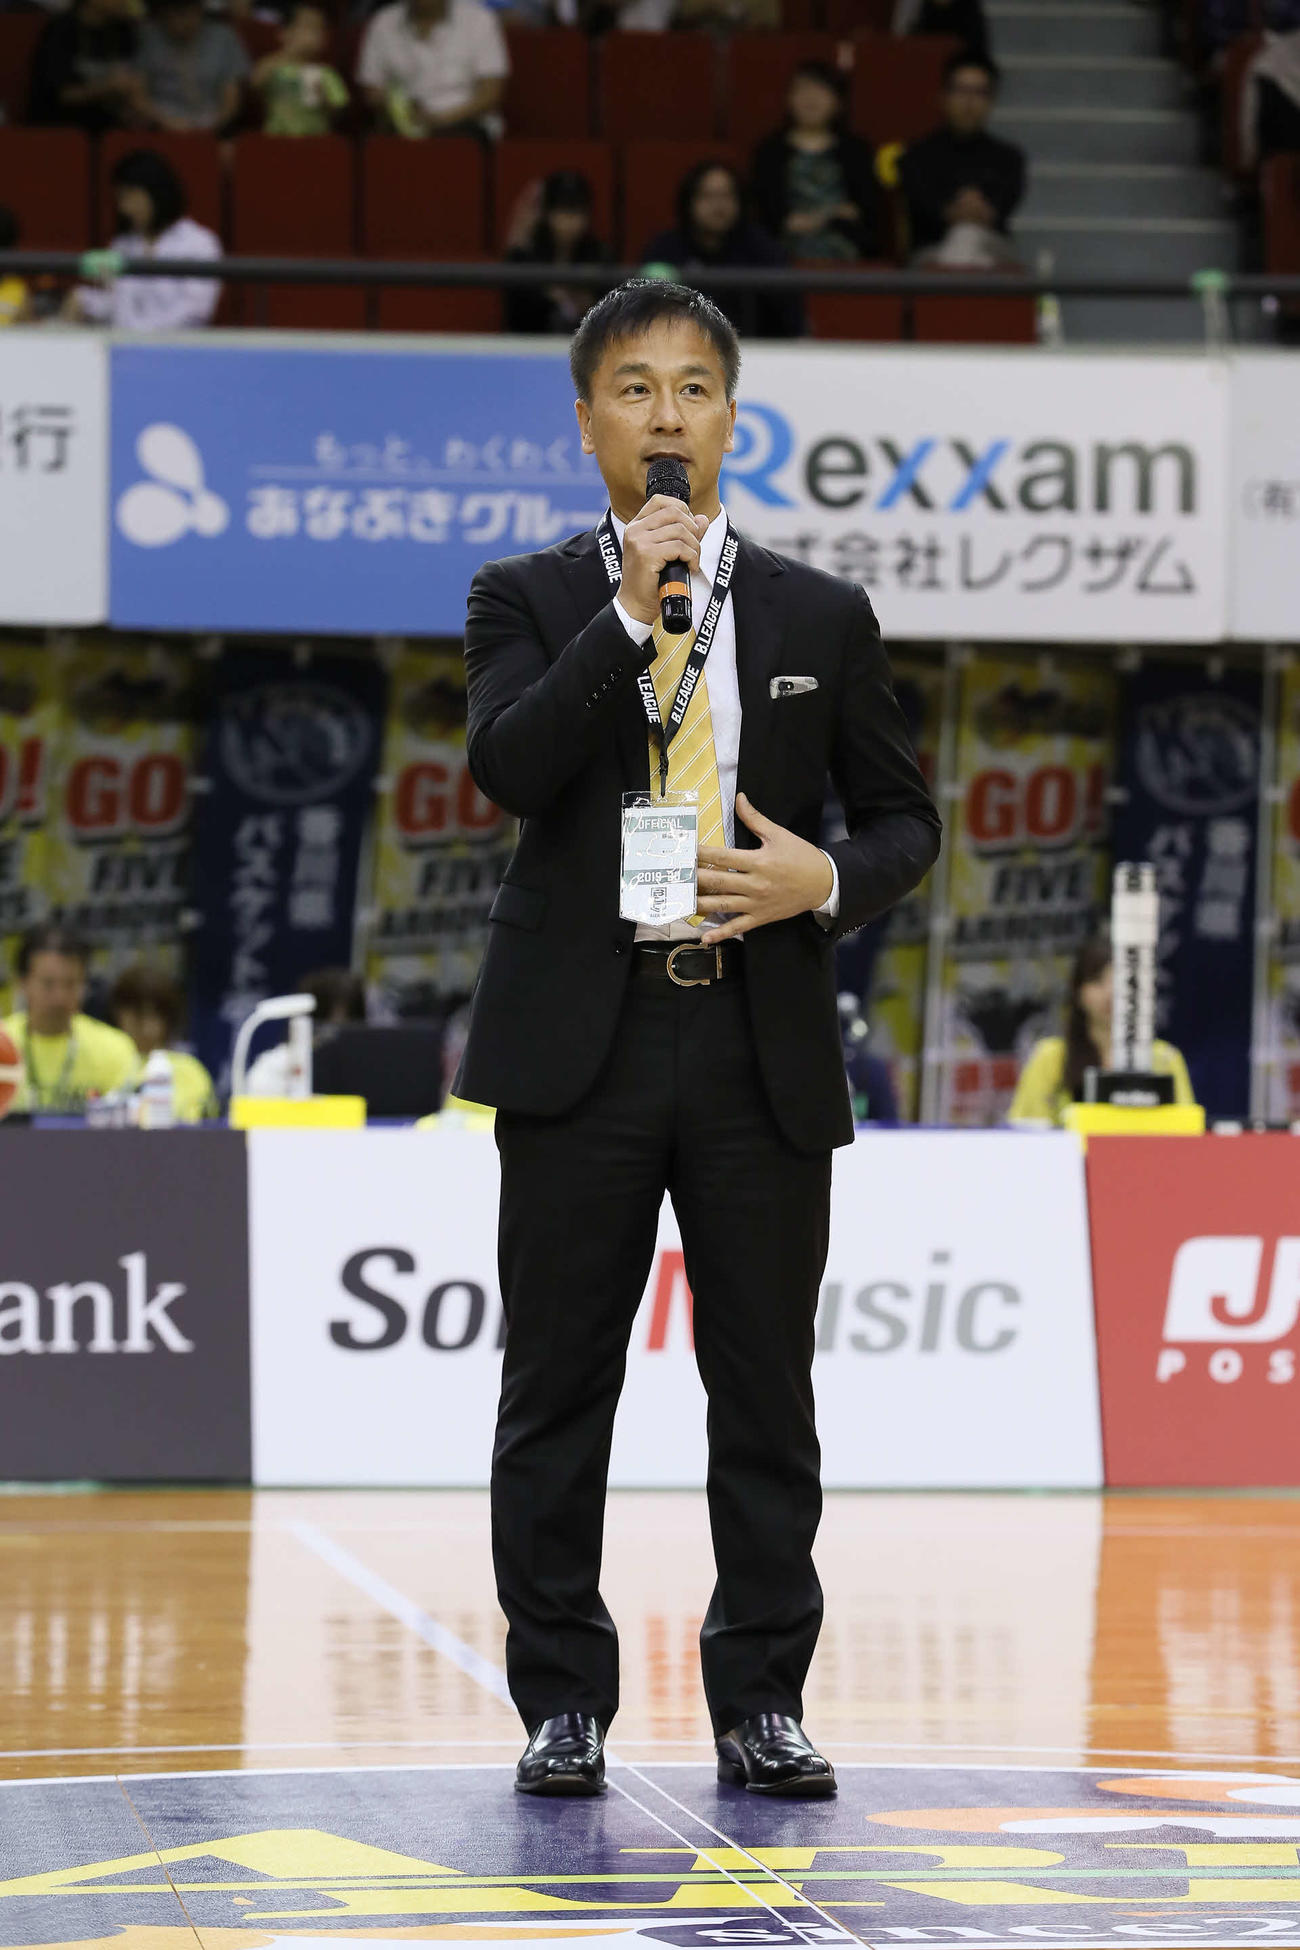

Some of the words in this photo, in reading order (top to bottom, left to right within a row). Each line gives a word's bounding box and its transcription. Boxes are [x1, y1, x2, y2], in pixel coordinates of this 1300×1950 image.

[718, 399, 1197, 514] Rexxam
[598, 532, 623, 584] B.LEAGUE
[715, 535, 740, 588] B.LEAGUE
[693, 595, 722, 656] B.LEAGUE
[670, 663, 700, 725] B.LEAGUE
[329, 1246, 504, 1352] So
